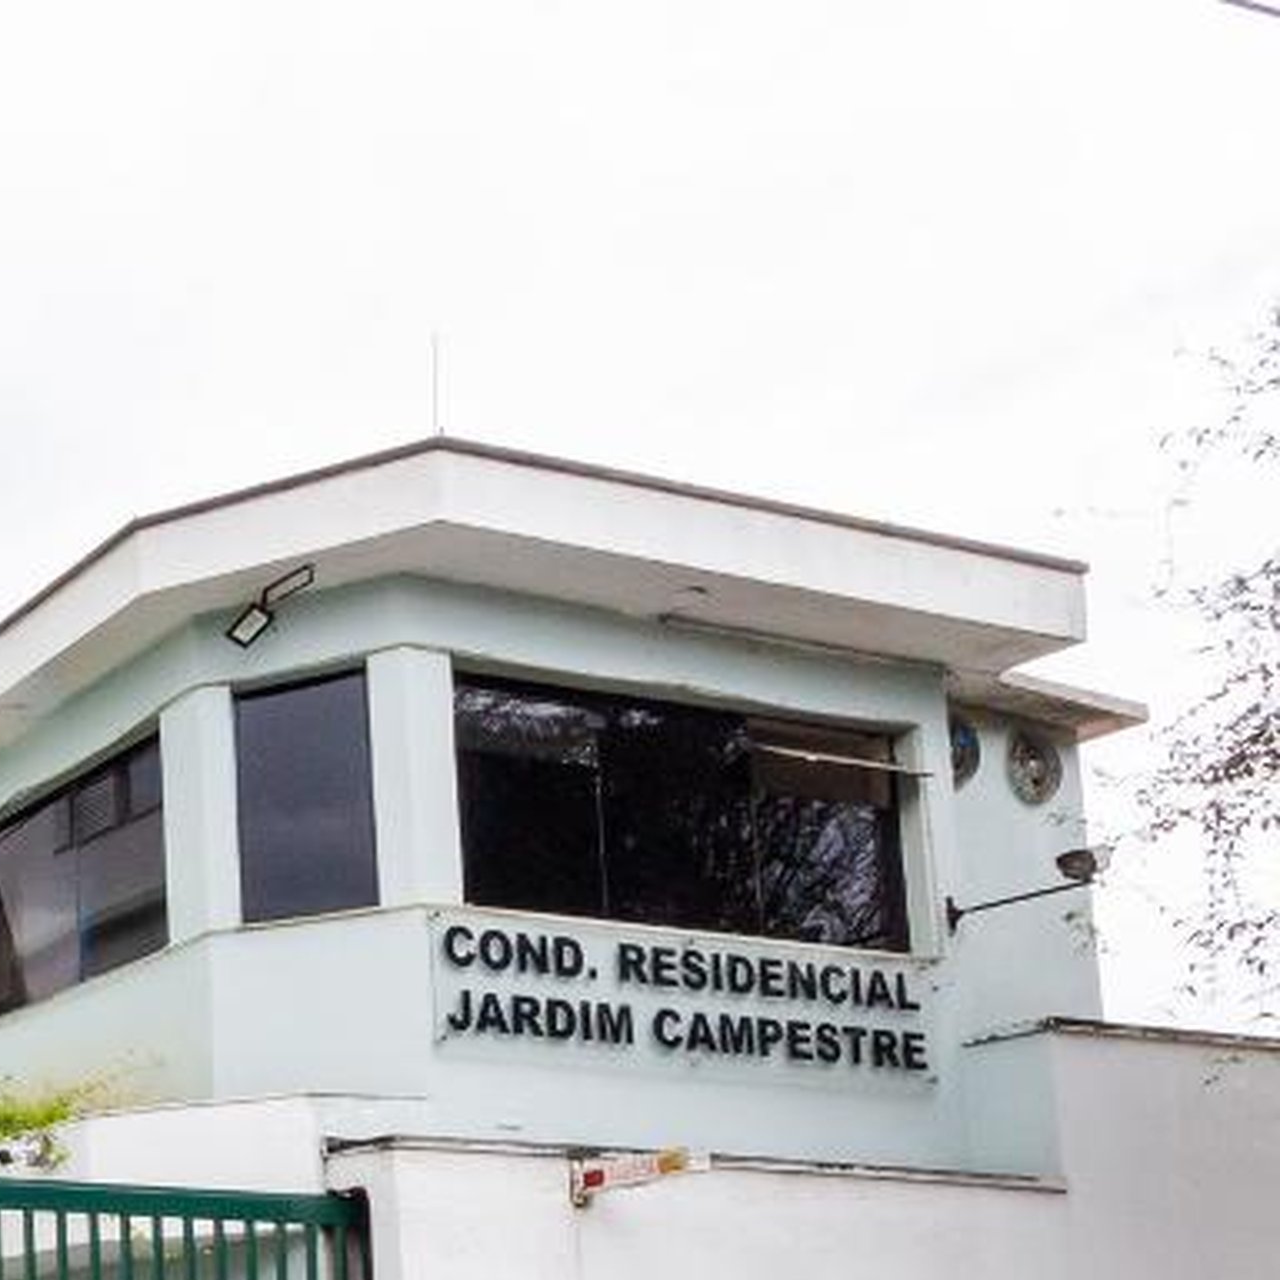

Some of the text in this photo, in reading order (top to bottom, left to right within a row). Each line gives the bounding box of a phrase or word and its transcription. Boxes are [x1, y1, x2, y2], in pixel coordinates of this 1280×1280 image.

[443, 925, 922, 1012] COND. RESIDENCIAL
[447, 989, 929, 1072] JARDIM CAMPESTRE
